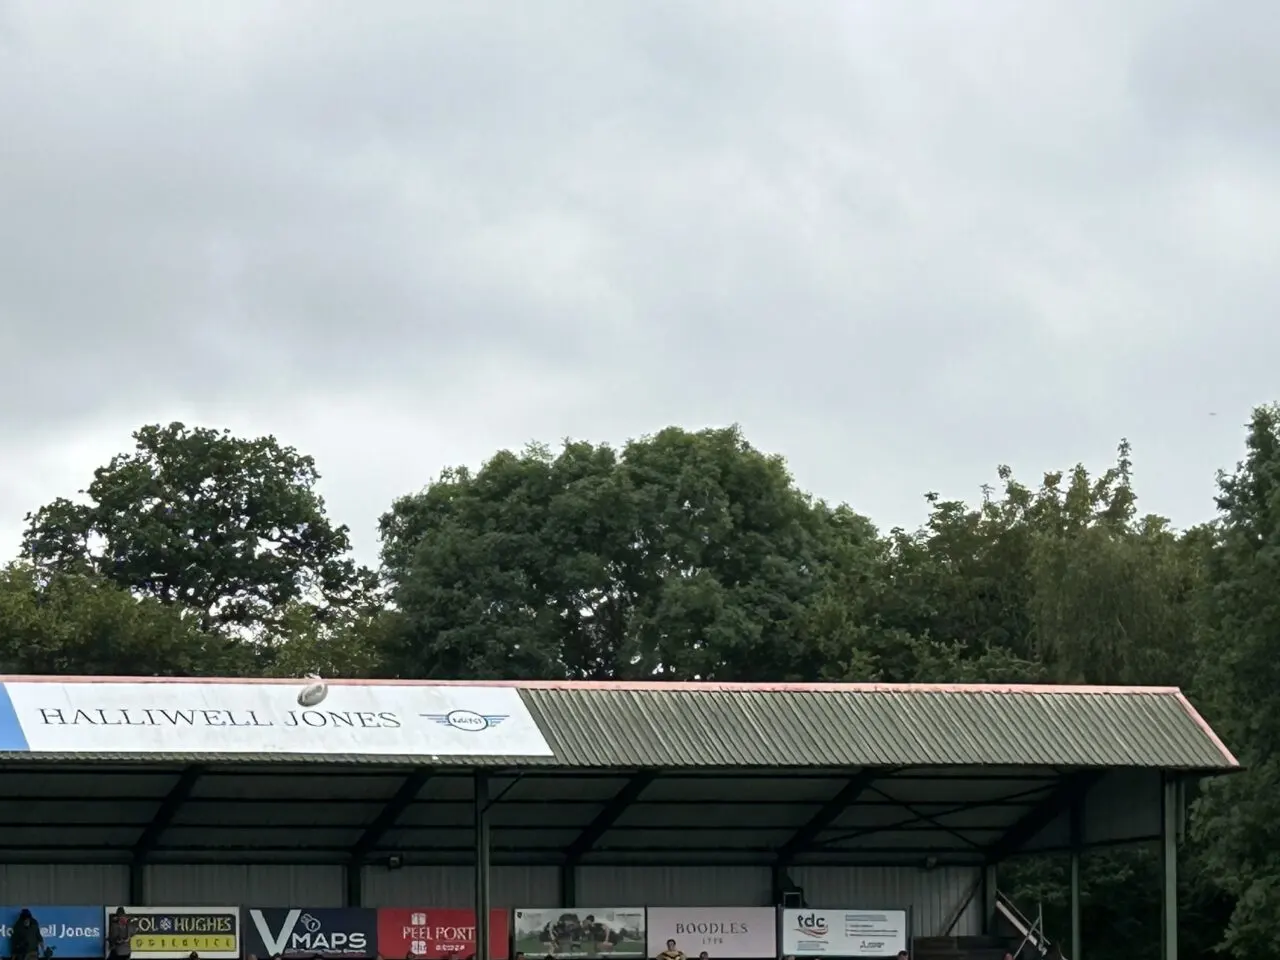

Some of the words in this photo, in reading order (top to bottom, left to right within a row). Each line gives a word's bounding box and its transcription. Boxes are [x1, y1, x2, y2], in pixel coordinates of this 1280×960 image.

[38, 707, 274, 728] HALLIWELL
[284, 708, 401, 729] JONES
[175, 917, 232, 931] HUGHES
[676, 922, 749, 934] BOODLES
[59, 924, 100, 939] Jones
[403, 926, 433, 940] PEEL
